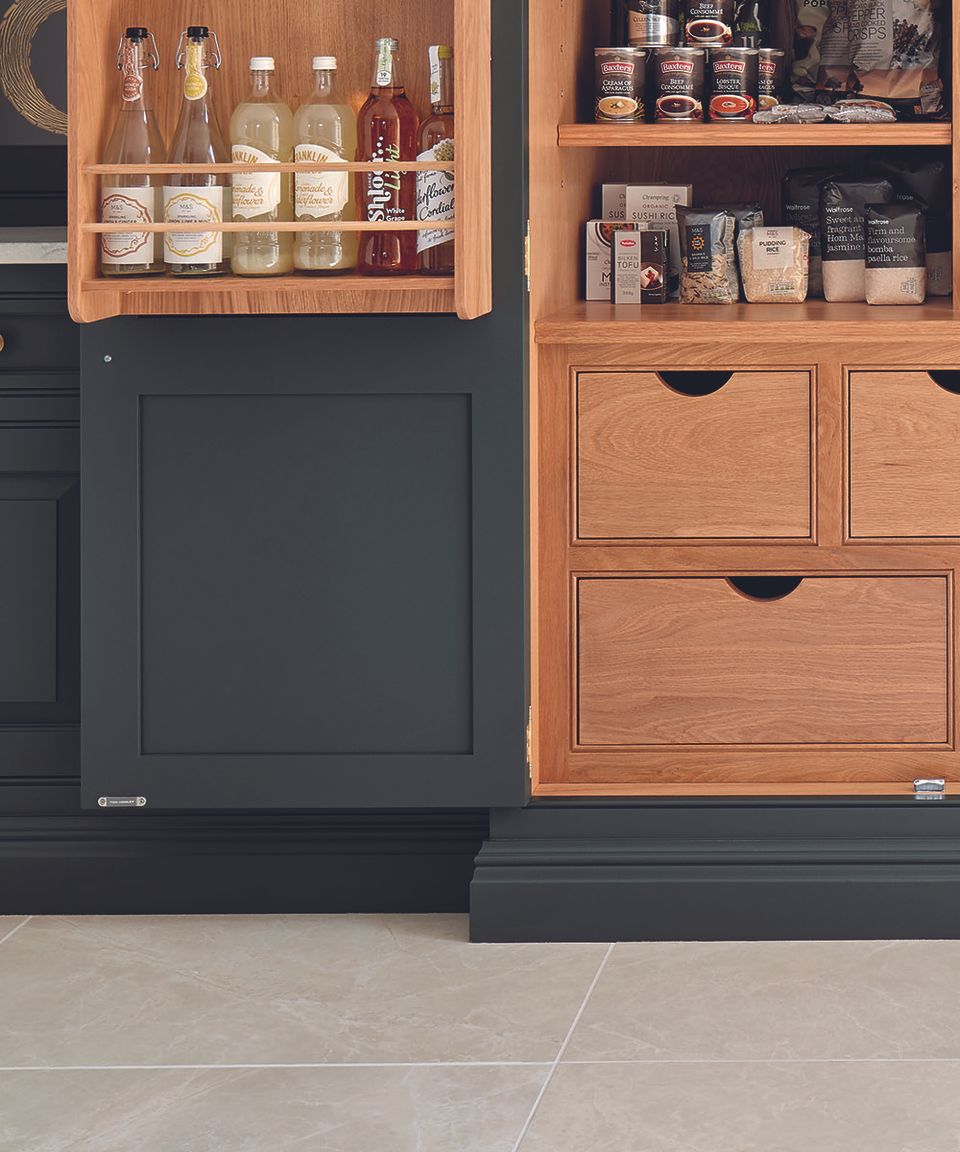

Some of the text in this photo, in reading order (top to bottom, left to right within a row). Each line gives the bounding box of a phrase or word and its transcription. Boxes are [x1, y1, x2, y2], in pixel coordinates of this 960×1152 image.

[848, 28, 887, 41] CRISPS
[602, 65, 633, 74] Baxters
[662, 65, 693, 73] Baxters
[714, 64, 744, 73] Baxters
[419, 200, 454, 221] Cordial
[826, 216, 852, 224] Sweet
[827, 234, 848, 242] Hom
[759, 240, 786, 248] PUDDING
[827, 243, 860, 253] jasmine
[868, 254, 908, 263] paella rice
